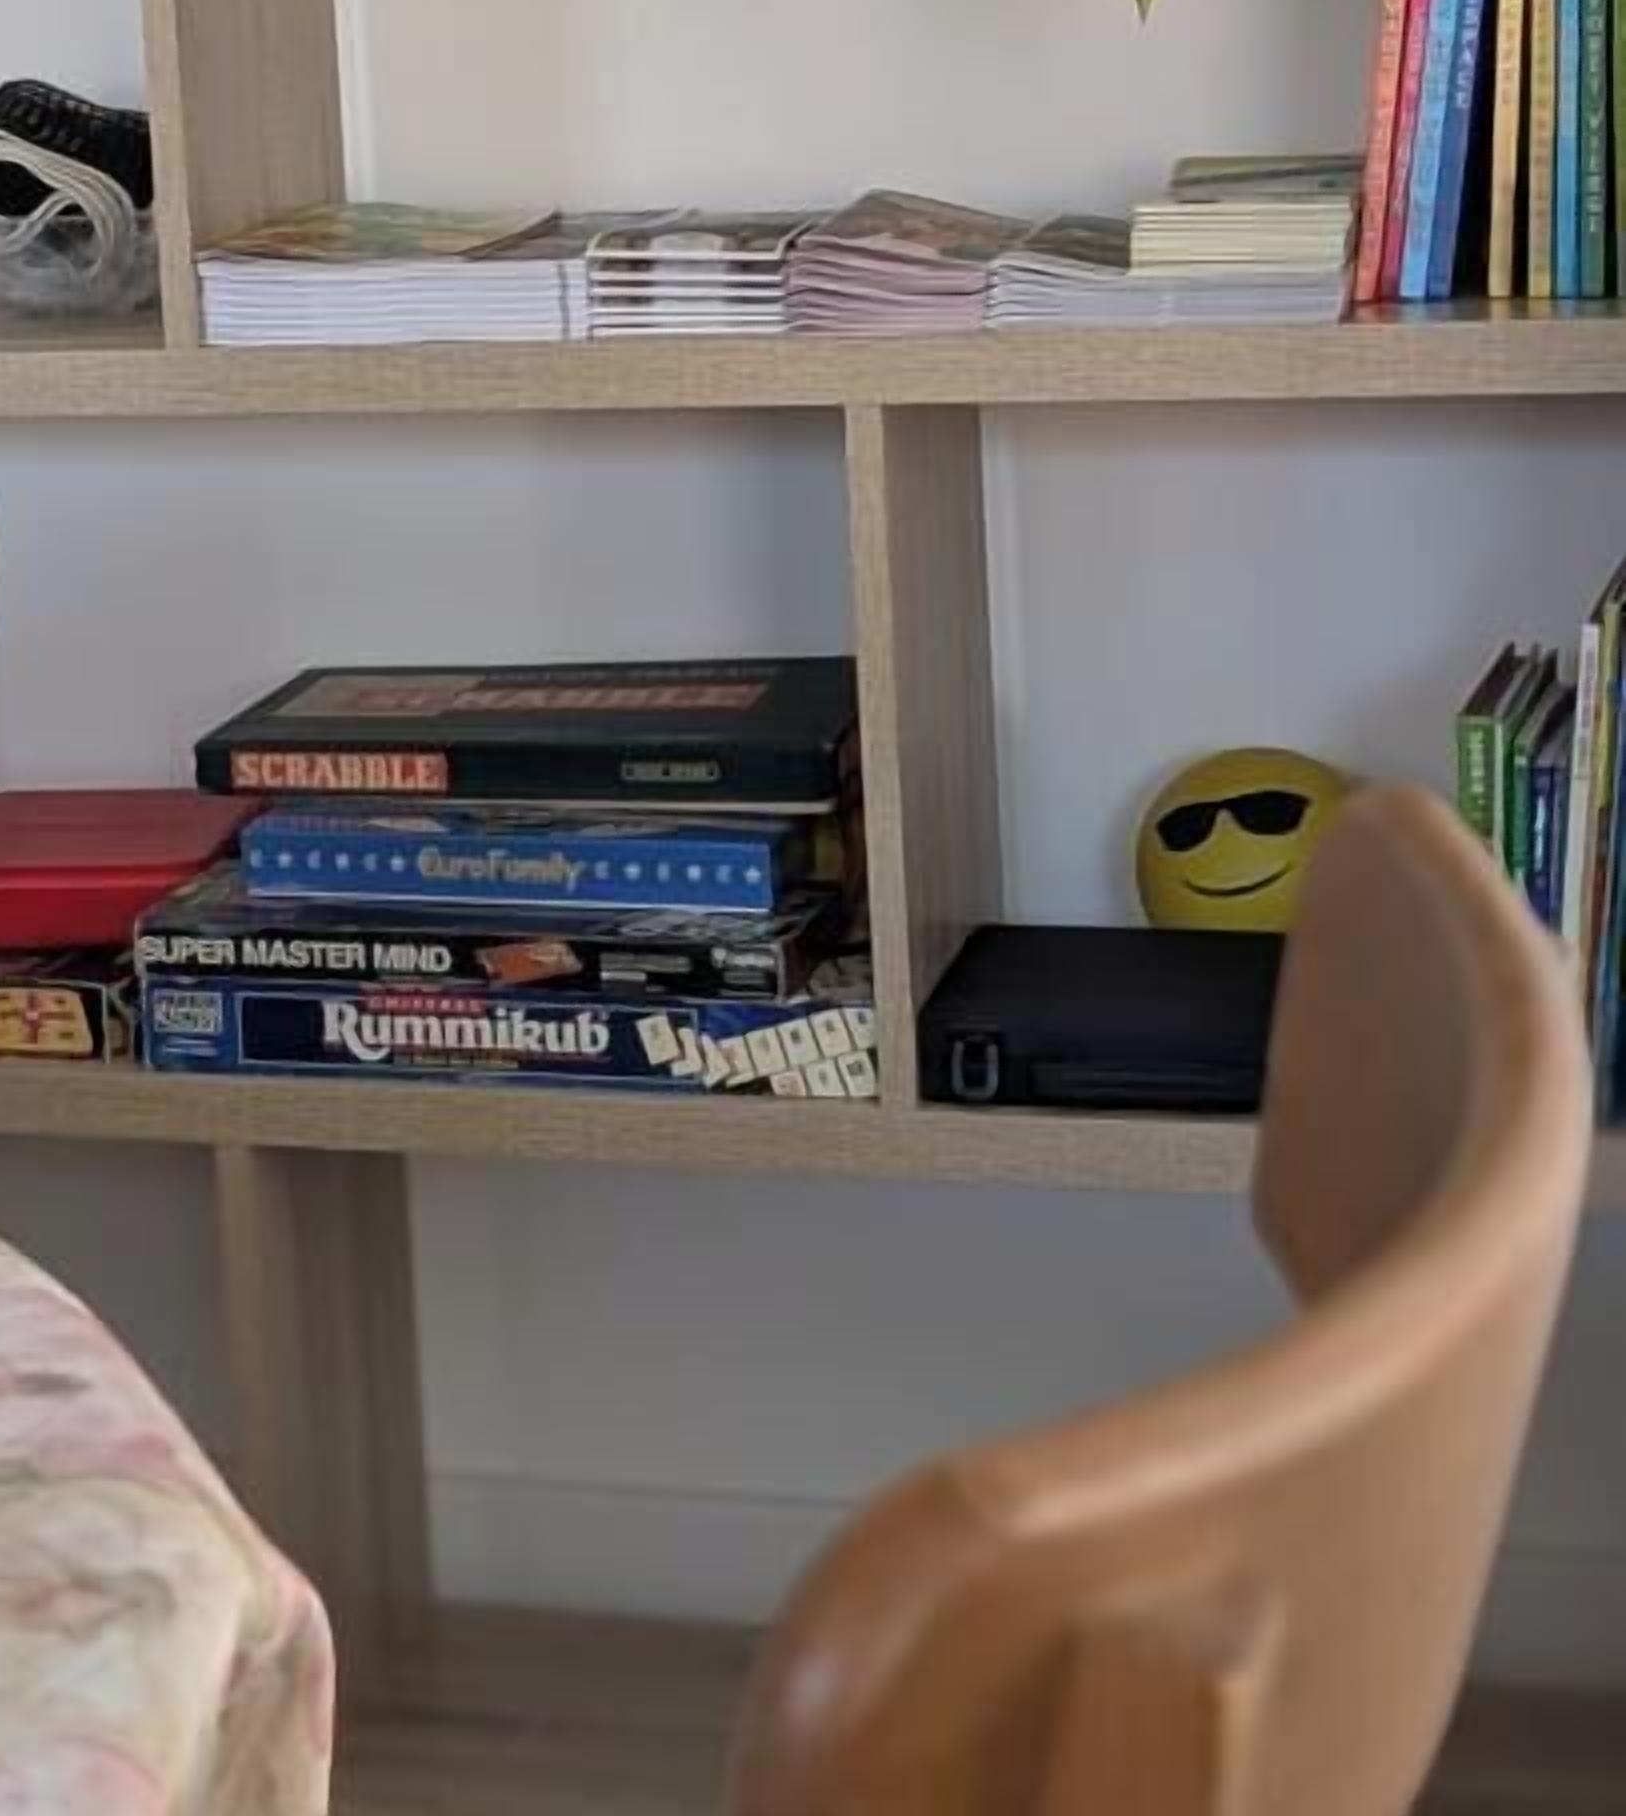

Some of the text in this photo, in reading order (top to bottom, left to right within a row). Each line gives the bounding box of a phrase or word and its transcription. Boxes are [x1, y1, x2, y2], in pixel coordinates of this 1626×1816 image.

[234, 752, 441, 789] SCRABBLE
[141, 936, 453, 972] SUPER MASTER MIND
[323, 999, 611, 1062] Rummikub
